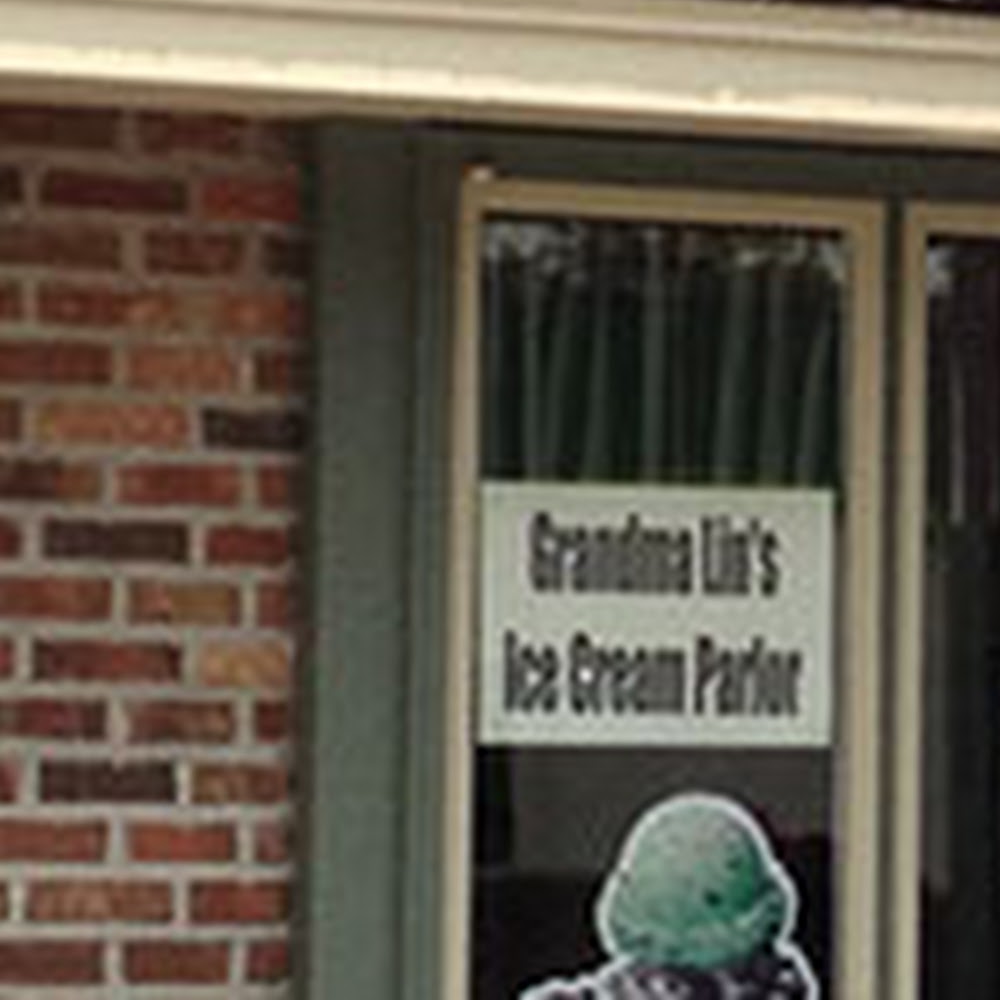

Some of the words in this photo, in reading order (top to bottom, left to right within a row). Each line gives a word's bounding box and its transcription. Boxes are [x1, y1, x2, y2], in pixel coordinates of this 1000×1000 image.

[528, 511, 693, 594] Grandma
[503, 629, 558, 714] Ice
[570, 630, 686, 716] Cream
[695, 634, 803, 718] Parlor
